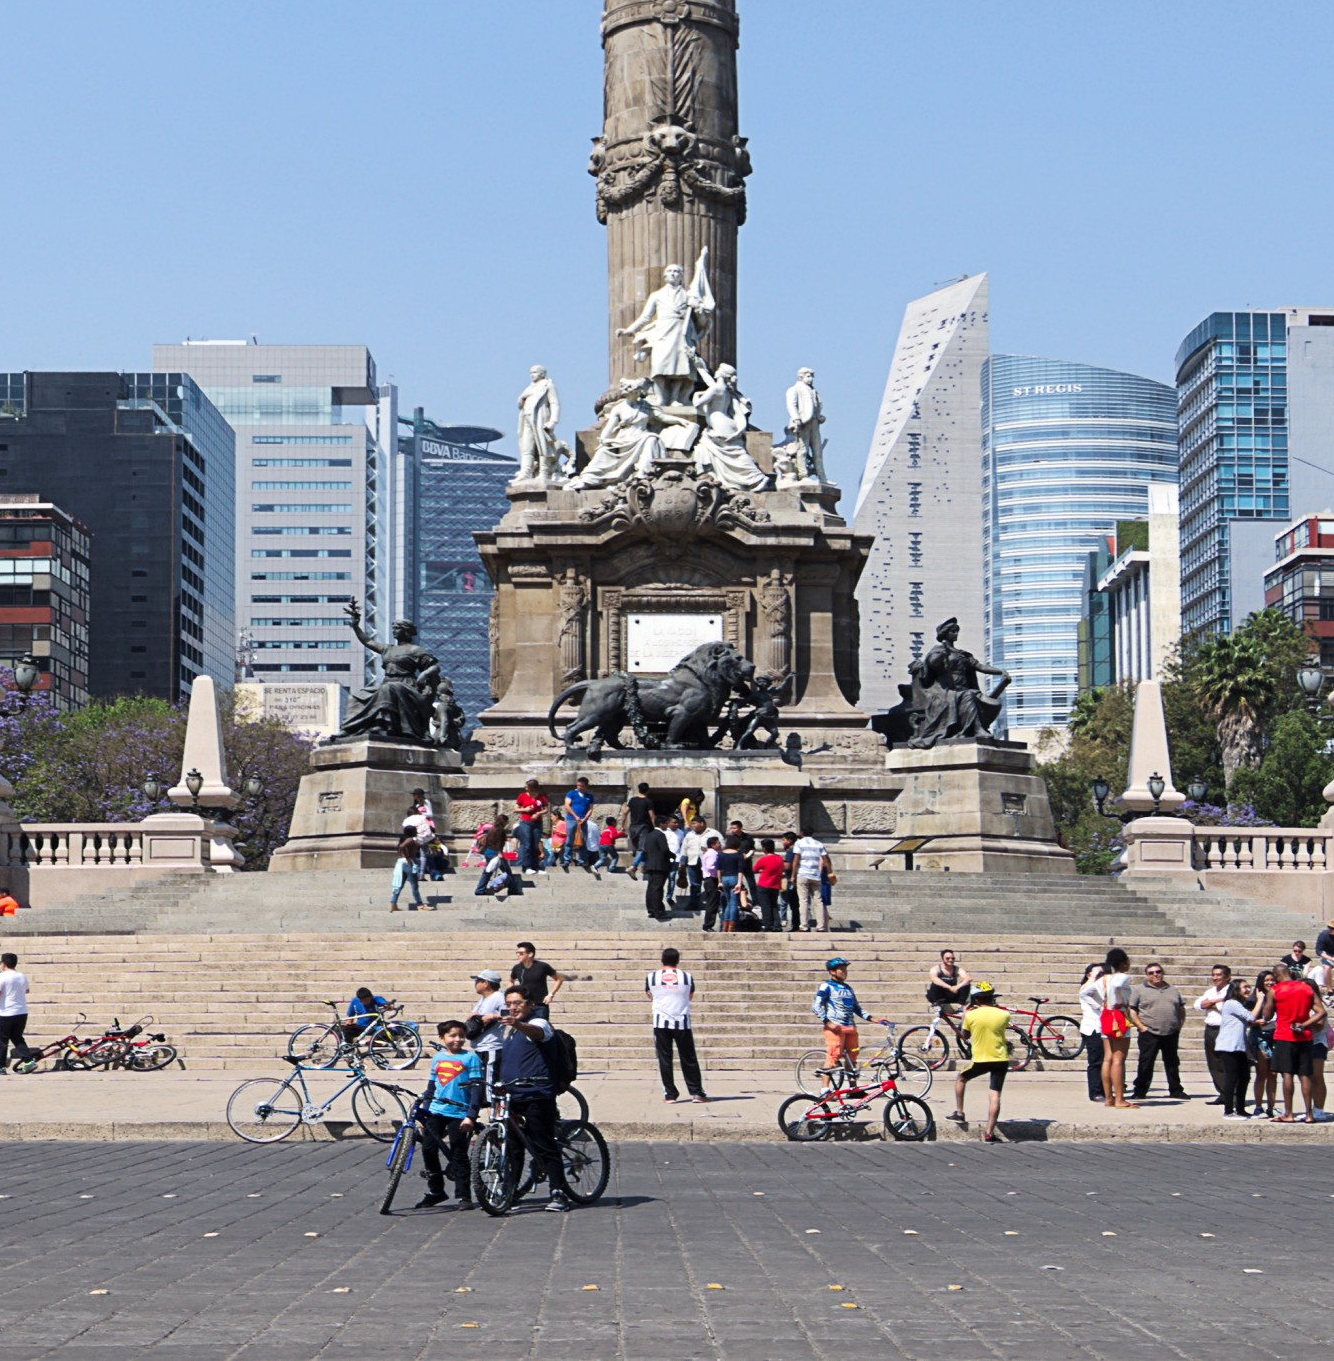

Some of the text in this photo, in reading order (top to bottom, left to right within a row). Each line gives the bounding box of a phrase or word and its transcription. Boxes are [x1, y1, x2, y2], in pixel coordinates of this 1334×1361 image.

[1013, 383, 1082, 396] ST REGIS
[422, 440, 451, 458] BBVA
